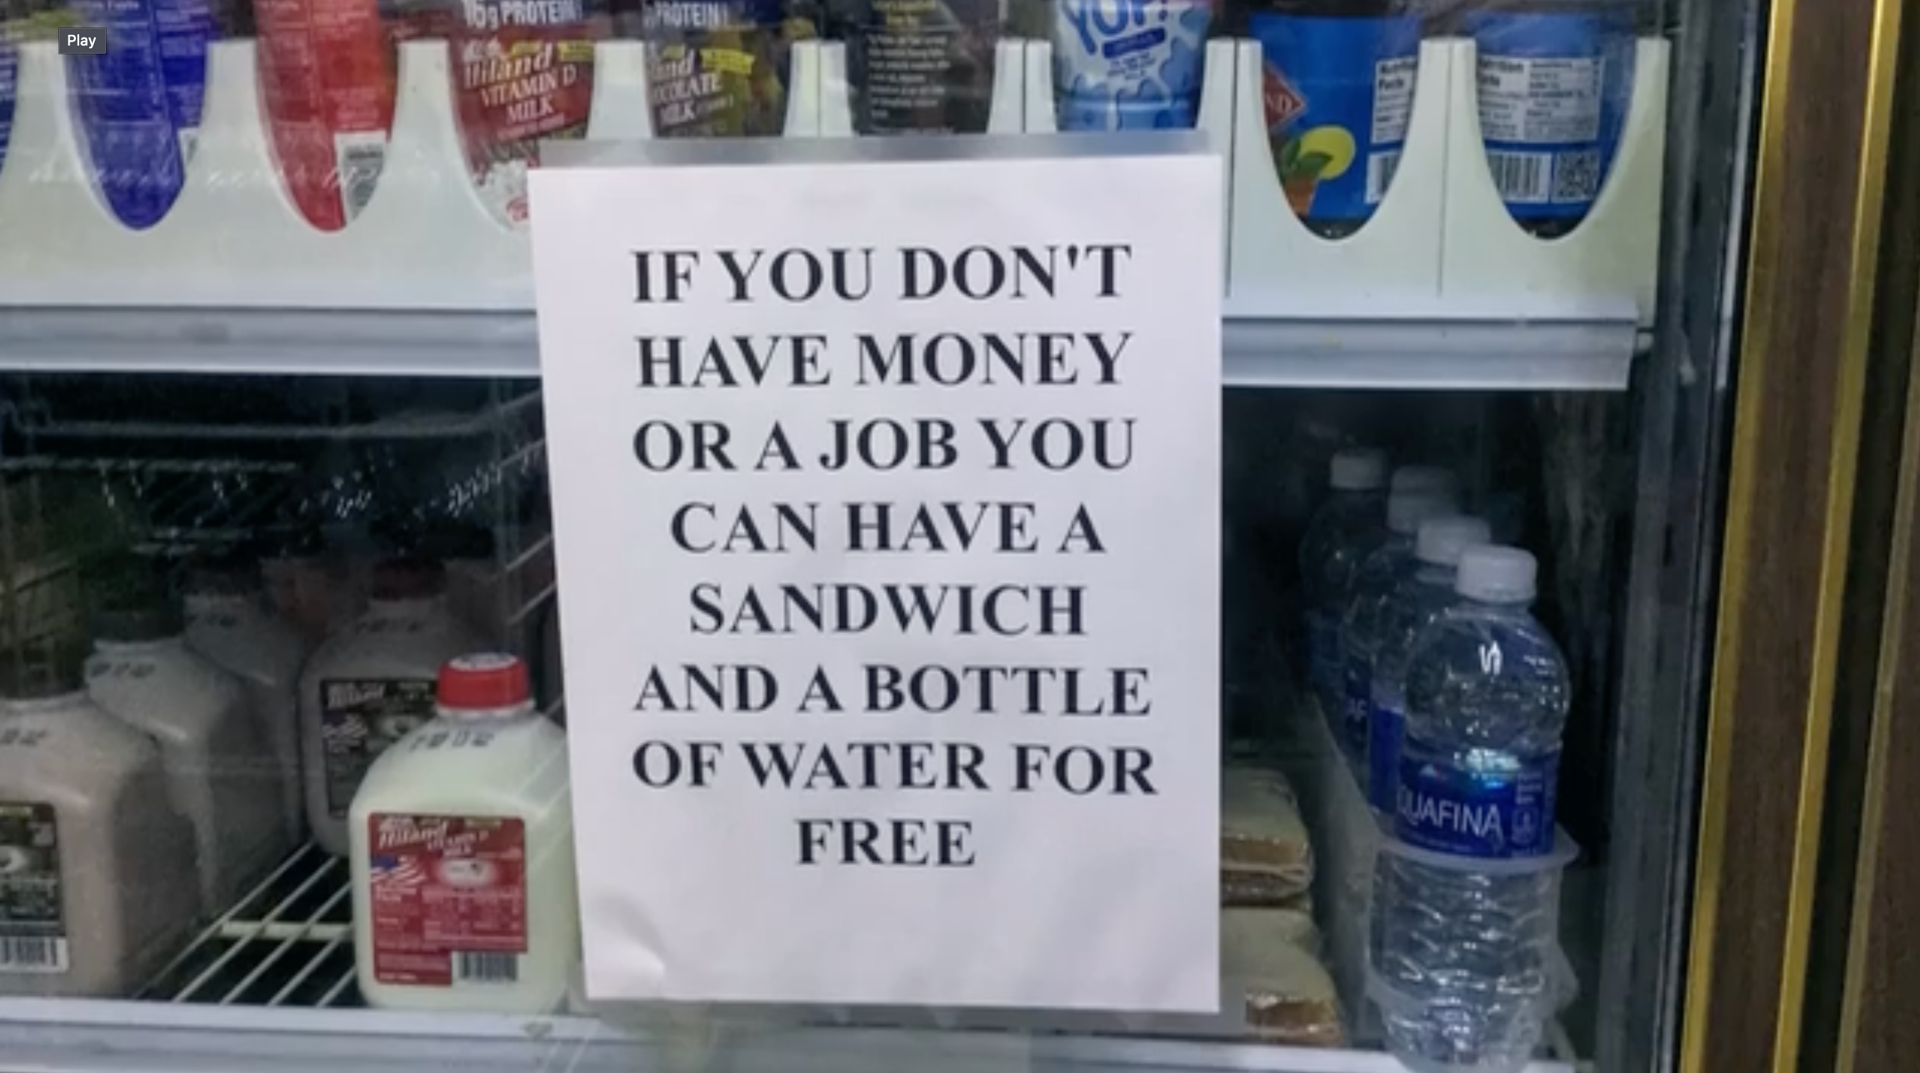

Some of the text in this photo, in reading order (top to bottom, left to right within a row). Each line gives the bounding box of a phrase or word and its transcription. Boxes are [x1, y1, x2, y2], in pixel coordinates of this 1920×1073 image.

[464, 42, 553, 90] Hiland
[480, 63, 577, 108] VITAMIN D
[506, 96, 554, 124] MILK
[632, 244, 1133, 303] IF YOU DON'T
[636, 332, 1133, 388] HAVE MONEY
[631, 418, 1137, 472] OR A JOB YOU
[669, 501, 1106, 553] CAN HAVE A
[688, 583, 1086, 636] SANDWICH
[633, 663, 1151, 717] AND A BOTTLE
[631, 740, 1158, 796] OF WATER FOR
[1397, 786, 1504, 841] QUAFINA
[795, 818, 976, 868] FREE
